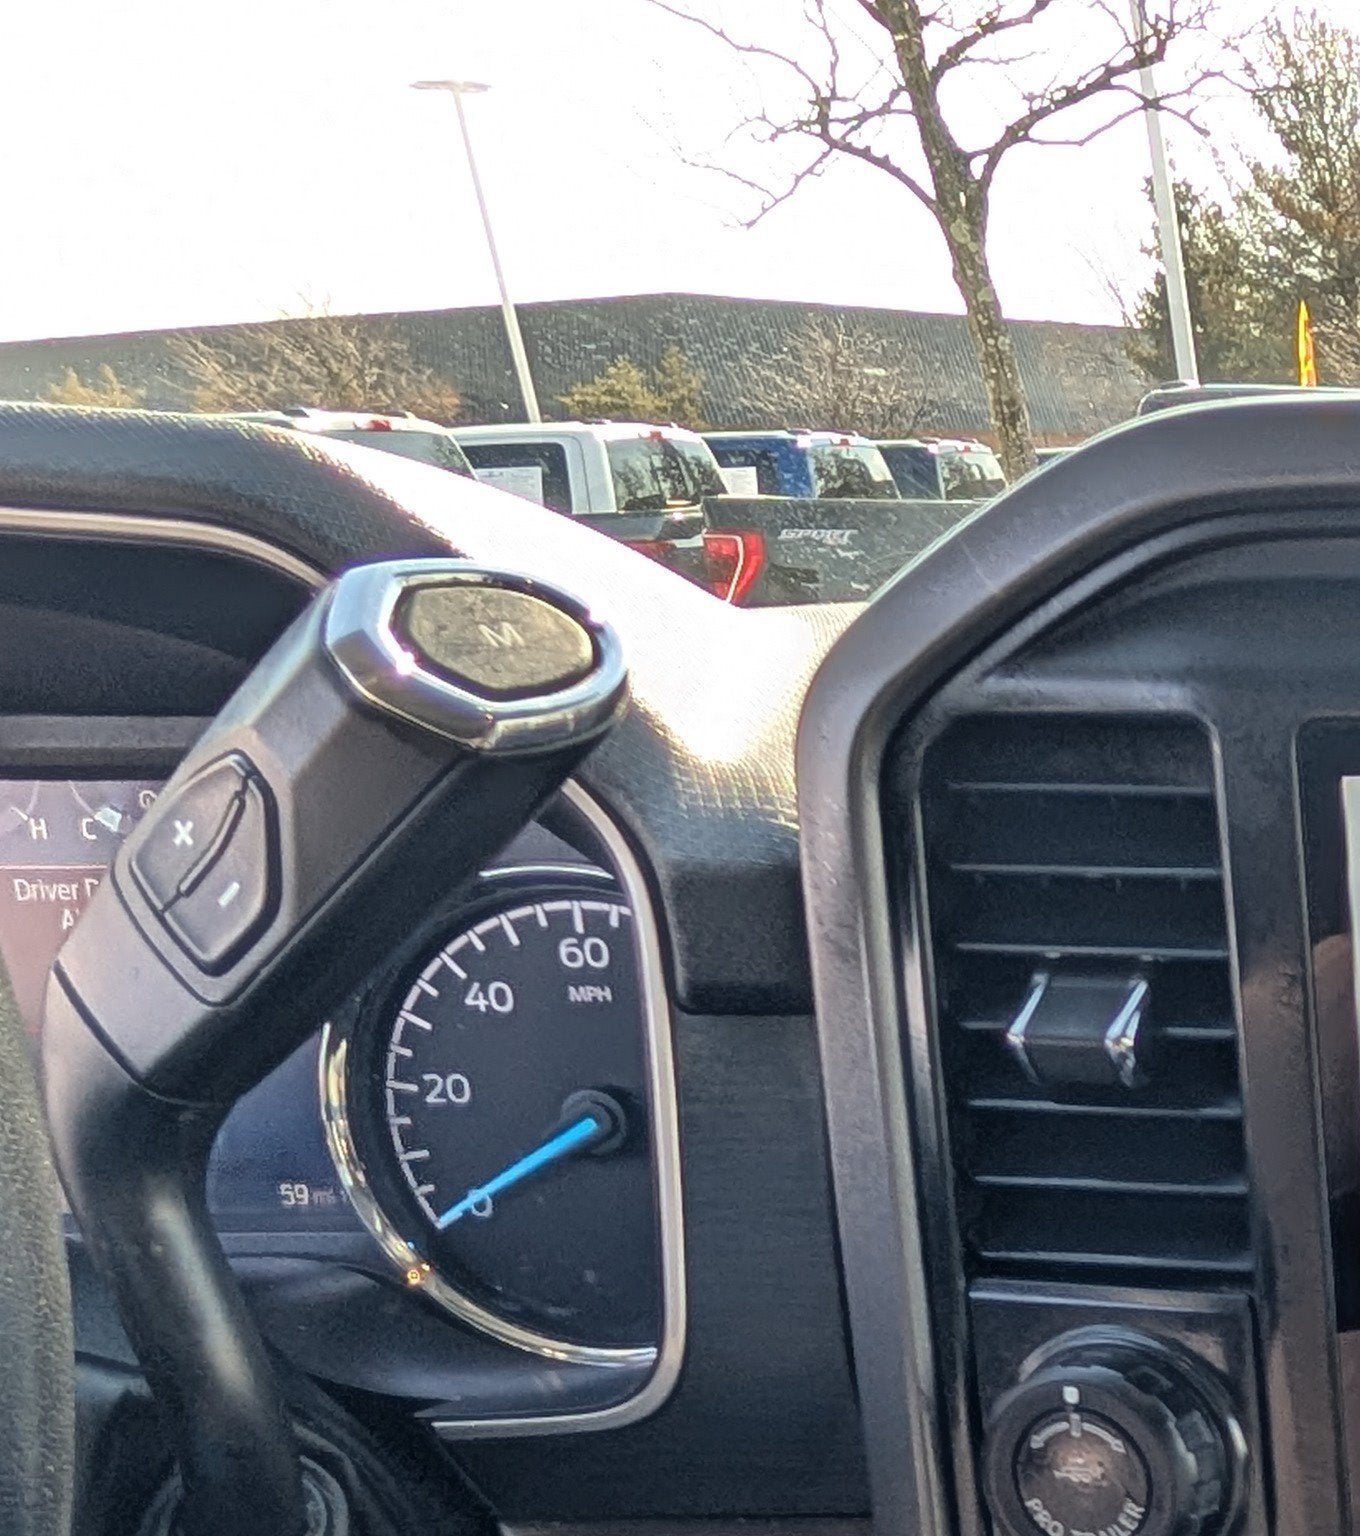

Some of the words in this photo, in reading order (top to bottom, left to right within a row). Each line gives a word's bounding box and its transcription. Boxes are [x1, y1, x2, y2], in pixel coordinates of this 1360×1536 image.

[477, 622, 526, 648] M
[29, 818, 48, 840] H
[13, 878, 79, 901] Driver
[559, 937, 610, 969] 60
[464, 981, 514, 1013] 40
[569, 984, 612, 1003] MPH
[422, 1072, 471, 1104] 20
[280, 1183, 309, 1206] 59
